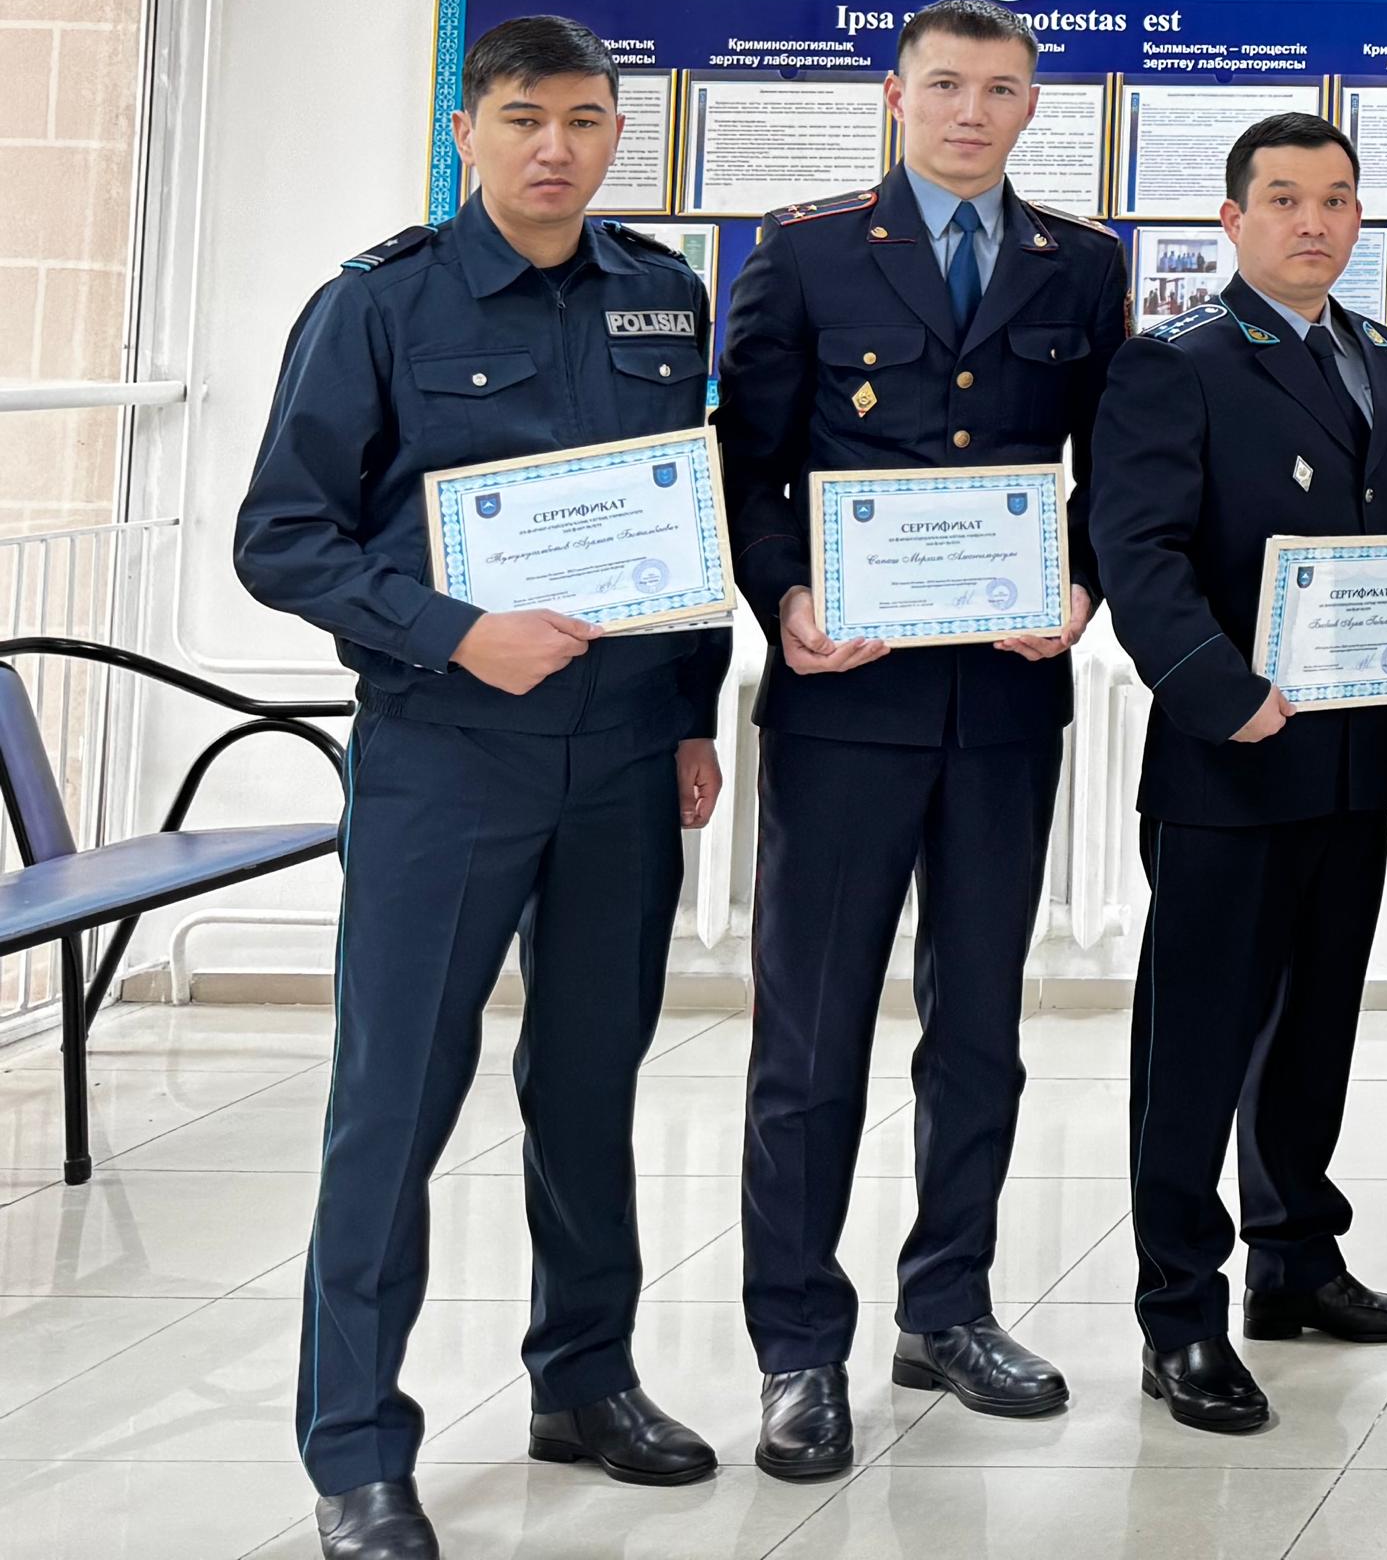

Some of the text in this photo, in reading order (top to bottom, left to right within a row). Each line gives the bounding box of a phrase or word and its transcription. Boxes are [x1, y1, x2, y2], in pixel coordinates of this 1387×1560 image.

[837, 6, 894, 35] Ipsa
[1144, 11, 1181, 31] est
[729, 38, 854, 52] Криминологиялық
[1143, 42, 1227, 55] Қылмыстық
[709, 54, 870, 68] зерттеу лабораториясы
[1143, 57, 1305, 71] зерттеу лабораториясы
[610, 313, 691, 332] POLISIA
[533, 498, 627, 524] СЕРТИФИКАТ
[901, 519, 983, 533] СЕРТИФИКАТ
